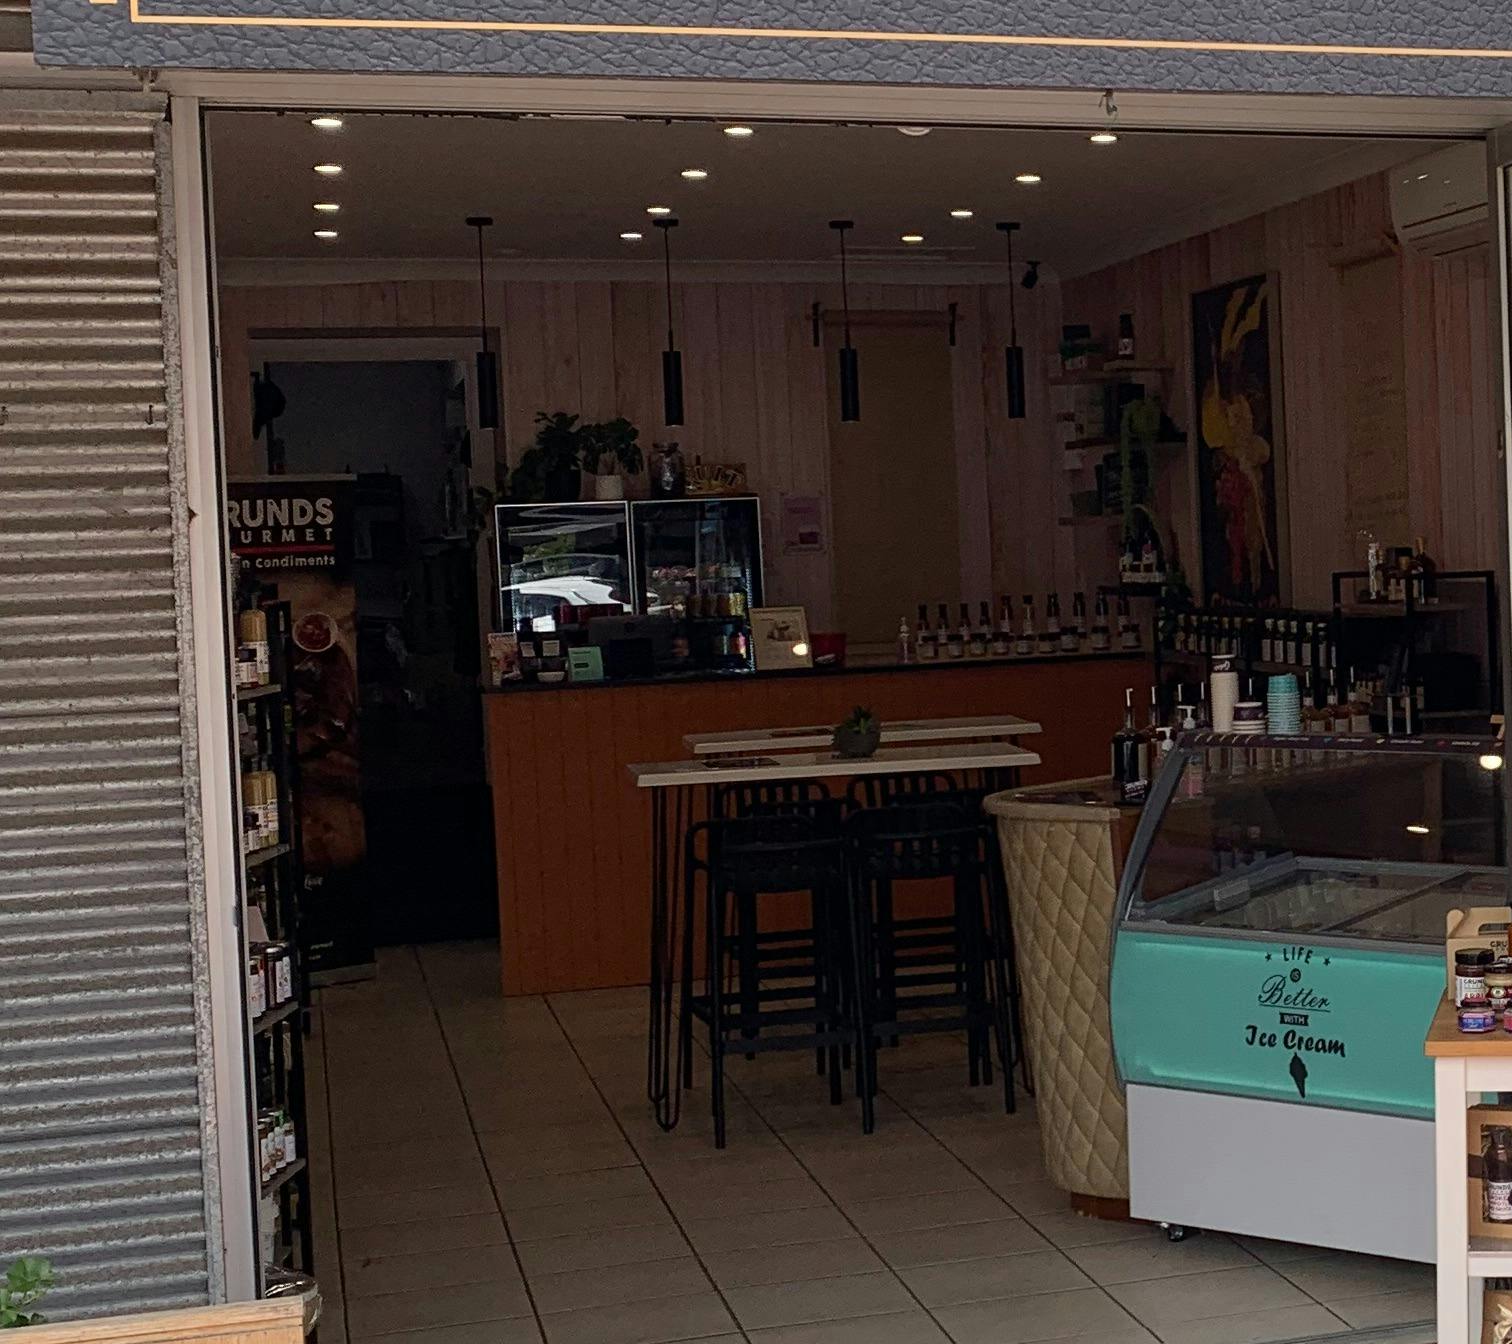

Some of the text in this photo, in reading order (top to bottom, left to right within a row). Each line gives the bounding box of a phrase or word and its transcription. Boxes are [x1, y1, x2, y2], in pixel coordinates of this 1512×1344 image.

[227, 497, 335, 528] RUNDS
[240, 527, 334, 544] URMET
[1490, 940, 1508, 948] GRU
[1282, 946, 1314, 964] LIFE
[1258, 974, 1330, 1009] Better
[1283, 1015, 1305, 1025] WITH
[1245, 1024, 1346, 1058] Ice Cream
